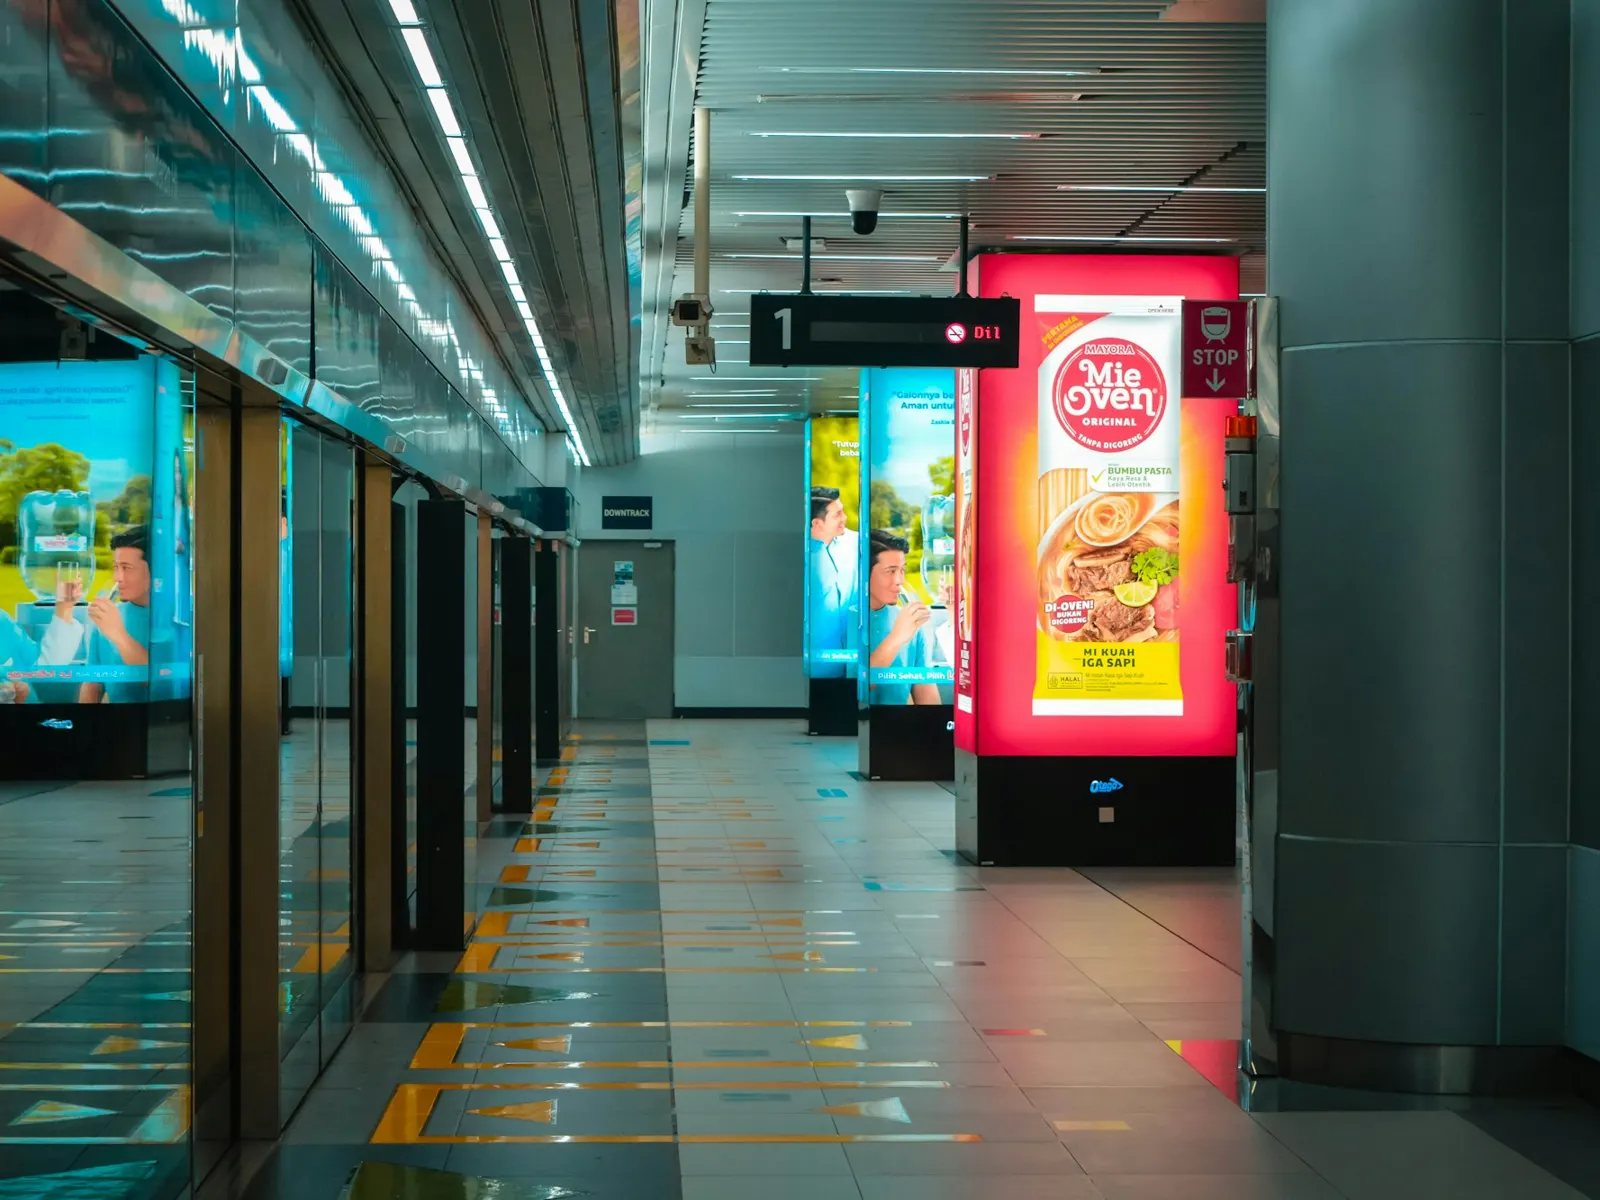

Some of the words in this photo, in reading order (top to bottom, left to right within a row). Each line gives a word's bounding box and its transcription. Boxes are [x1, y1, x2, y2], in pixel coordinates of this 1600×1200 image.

[773, 308, 792, 350] 1
[974, 326, 1001, 340] Dil
[1041, 315, 1079, 344] PERTAMA
[1084, 344, 1135, 355] MAYORA
[1192, 349, 1239, 366] STOP
[1078, 358, 1142, 387] Mie
[1063, 386, 1156, 417] Oven
[1082, 417, 1137, 426] ORIGINAL
[1078, 433, 1102, 449] TANPA
[1103, 433, 1143, 449] DIGORENG
[1108, 467, 1142, 475] BUMBU
[1144, 467, 1172, 475] PASTA
[604, 508, 650, 517] DOWNTRACK
[1045, 600, 1094, 613] DI-OVEN!
[1051, 617, 1087, 625] DIGORENG
[1084, 648, 1097, 656] MI
[1101, 648, 1135, 656] KUAH
[1082, 658, 1104, 667] IGA
[1107, 658, 1136, 667] SAPI
[899, 672, 925, 680] Sehat,
[926, 672, 946, 680] Pilih
